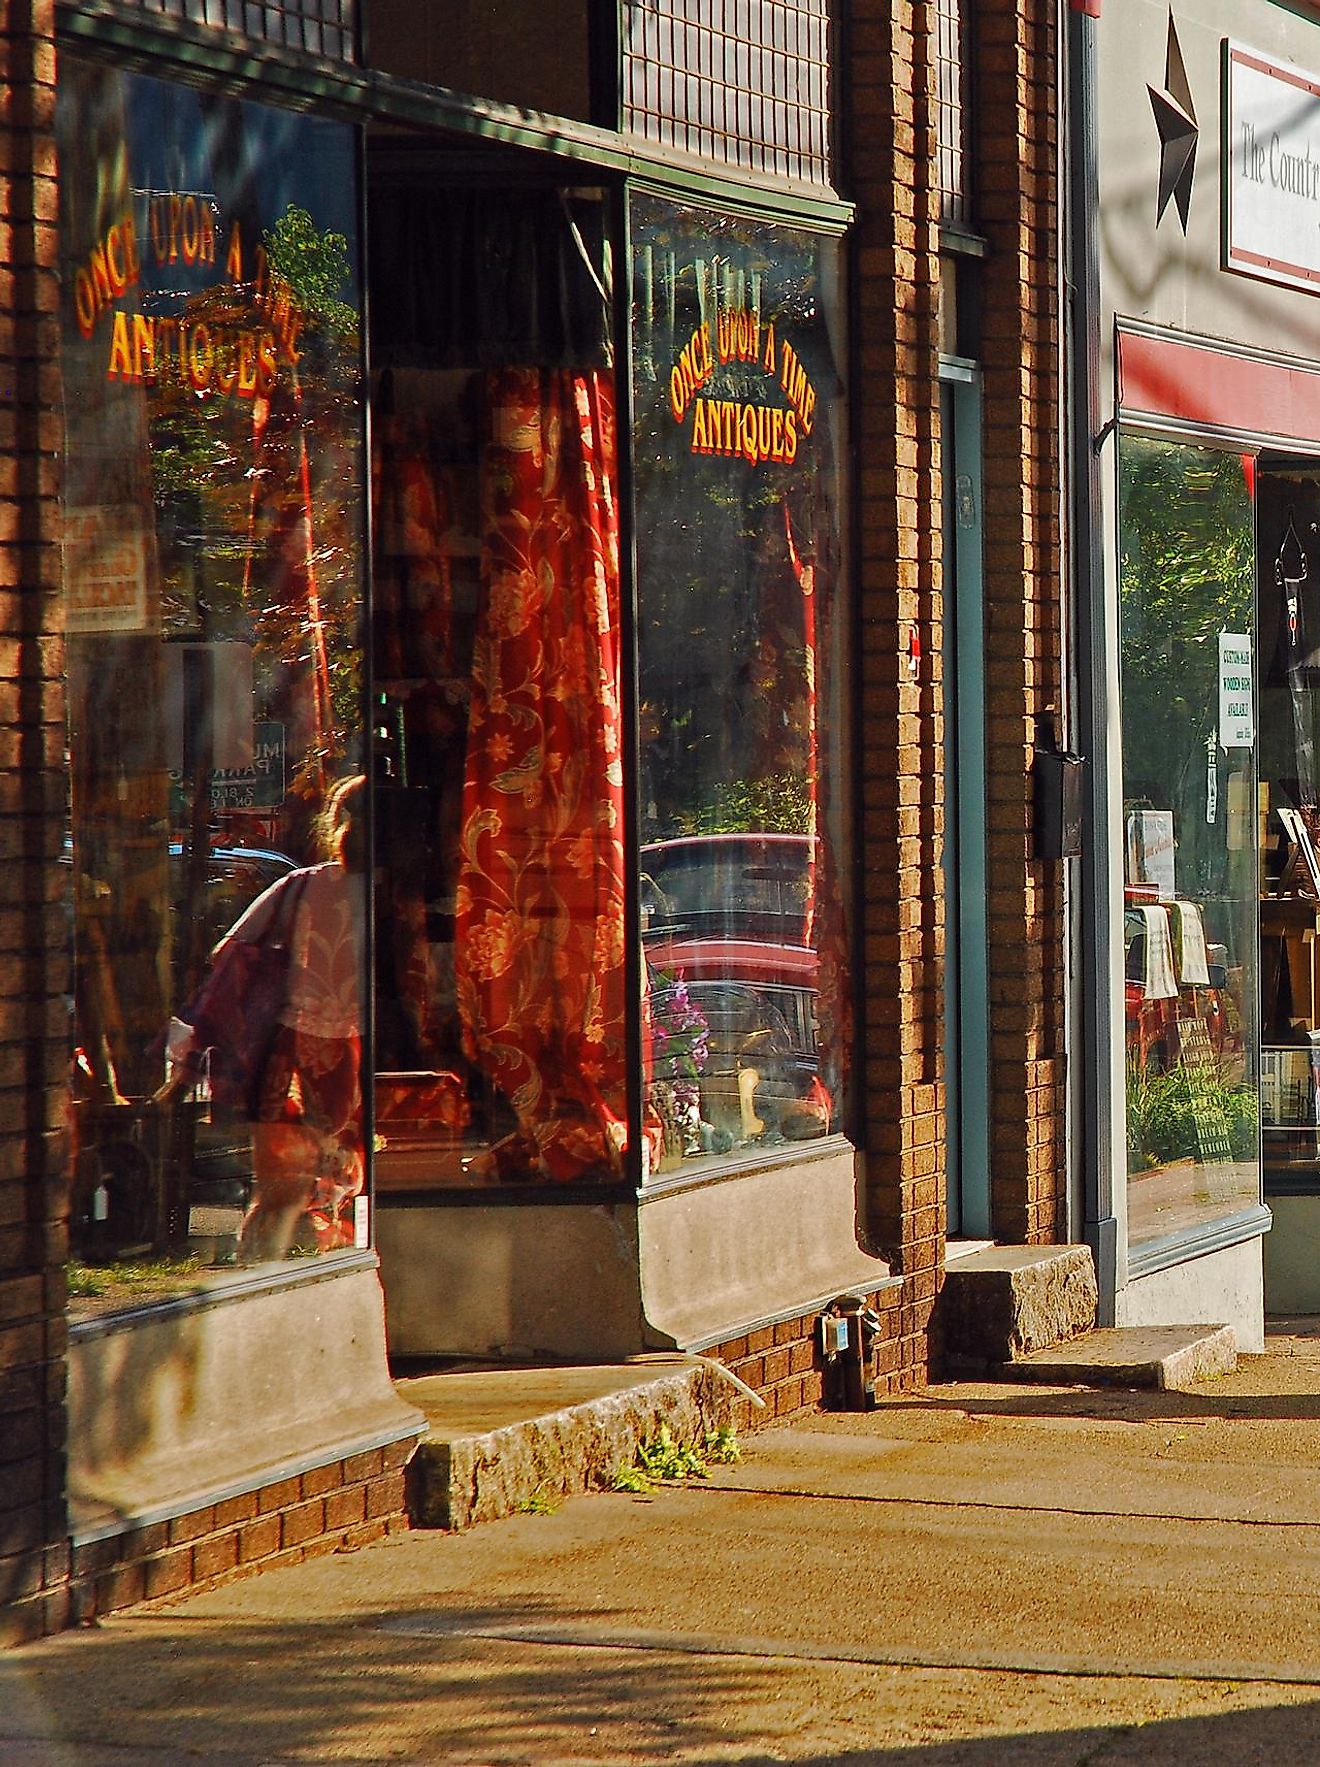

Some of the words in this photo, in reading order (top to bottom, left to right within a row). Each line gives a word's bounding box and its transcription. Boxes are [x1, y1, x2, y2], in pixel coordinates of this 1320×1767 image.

[1241, 121, 1265, 184] The
[75, 214, 140, 341] ONCE
[226, 220, 243, 284] A
[670, 319, 714, 424] ONCE
[716, 303, 761, 366] UPON
[763, 322, 776, 375] A
[780, 339, 816, 437] TIME
[691, 398, 797, 468] ANTIQUES
